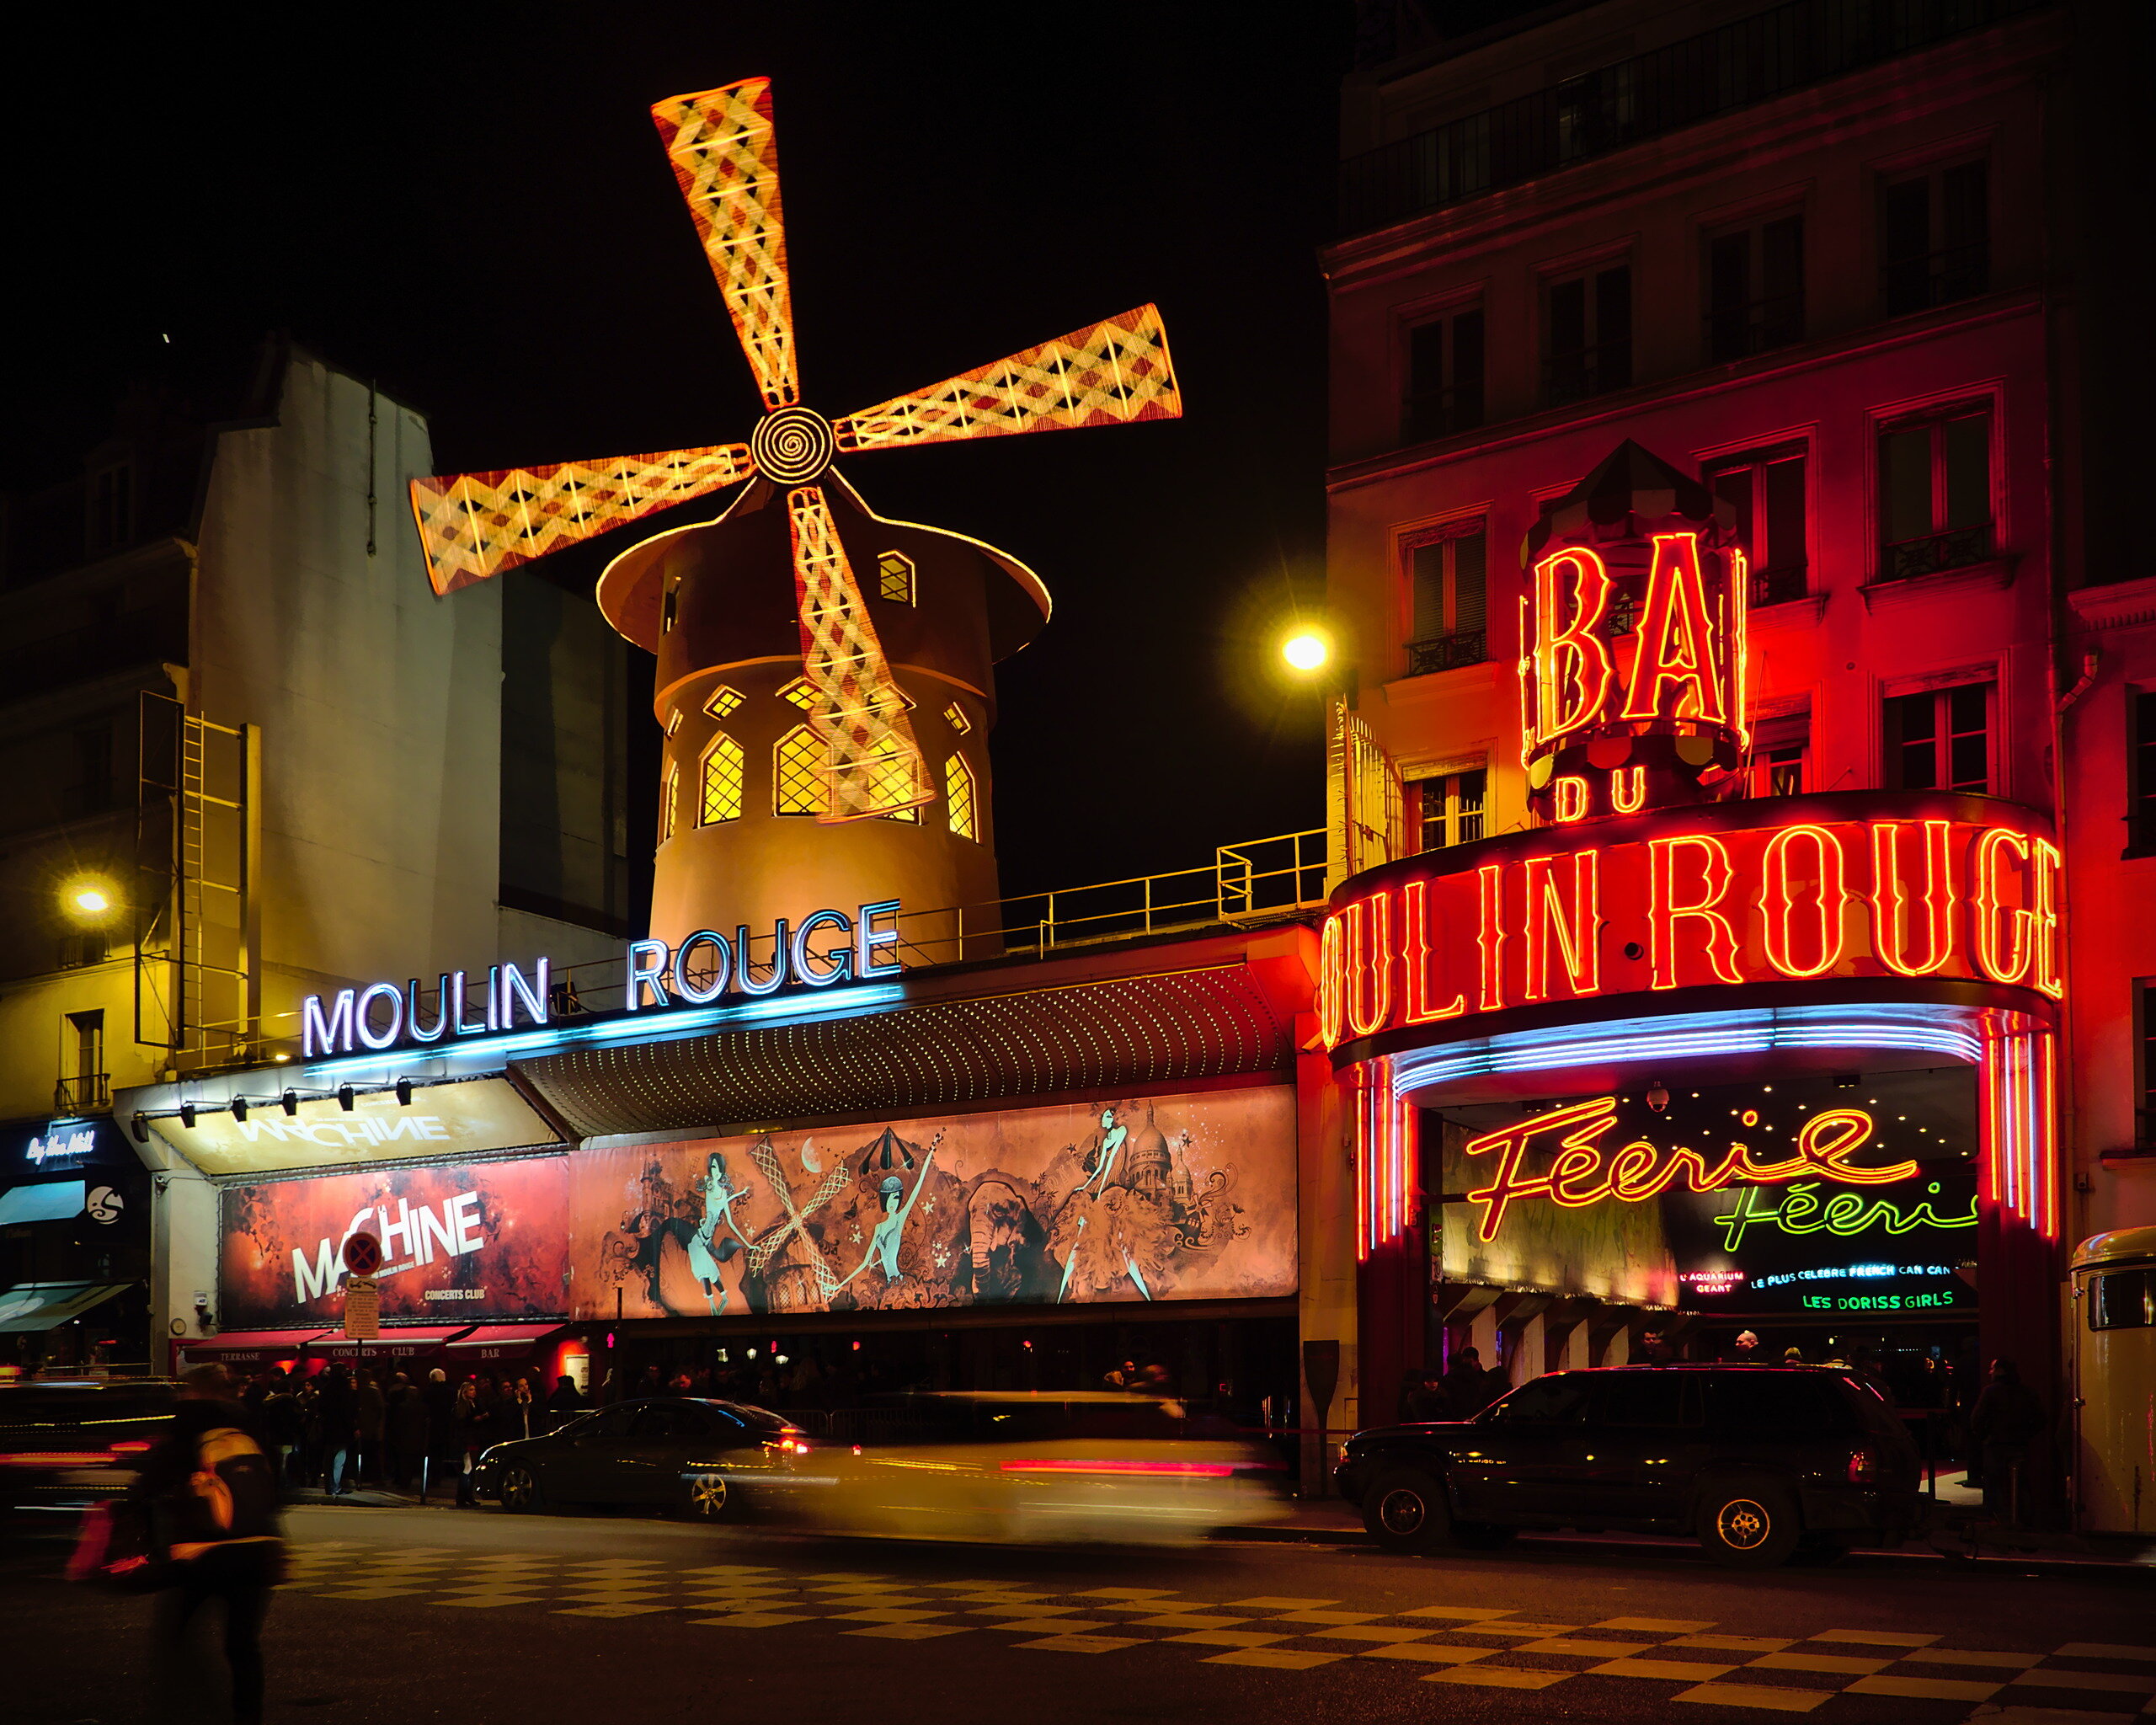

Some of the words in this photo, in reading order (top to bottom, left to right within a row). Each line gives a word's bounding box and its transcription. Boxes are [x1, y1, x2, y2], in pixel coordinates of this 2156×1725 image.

[1534, 531, 1751, 745] BA
[1556, 766, 1646, 822] DU
[1648, 820, 2063, 1000] ROUGE
[302, 955, 549, 1058] MOULIN
[627, 897, 903, 1011] ROUGE
[1465, 1095, 1918, 1243] Féerie
[1751, 1279, 1765, 1290] LE
[1768, 1273, 1796, 1287] PLUS
[1798, 1268, 1846, 1280] CELEBRE
[1849, 1264, 1895, 1277] FRENCH
[1899, 1265, 1923, 1275] CAN
[1927, 1265, 1951, 1275] CAN
[424, 1290, 464, 1300] CONCERTS
[465, 1289, 485, 1300] CLUB
[1696, 1284, 1732, 1294] GEANT
[1803, 1295, 1832, 1309] LES
[1838, 1295, 1901, 1310] DORISS
[1905, 1291, 1954, 1309] GIRLS
[221, 1352, 260, 1362] TERRASSE
[332, 1347, 377, 1357] CONCRTS
[392, 1346, 415, 1356] CLUB
[481, 1348, 499, 1358] BAR
